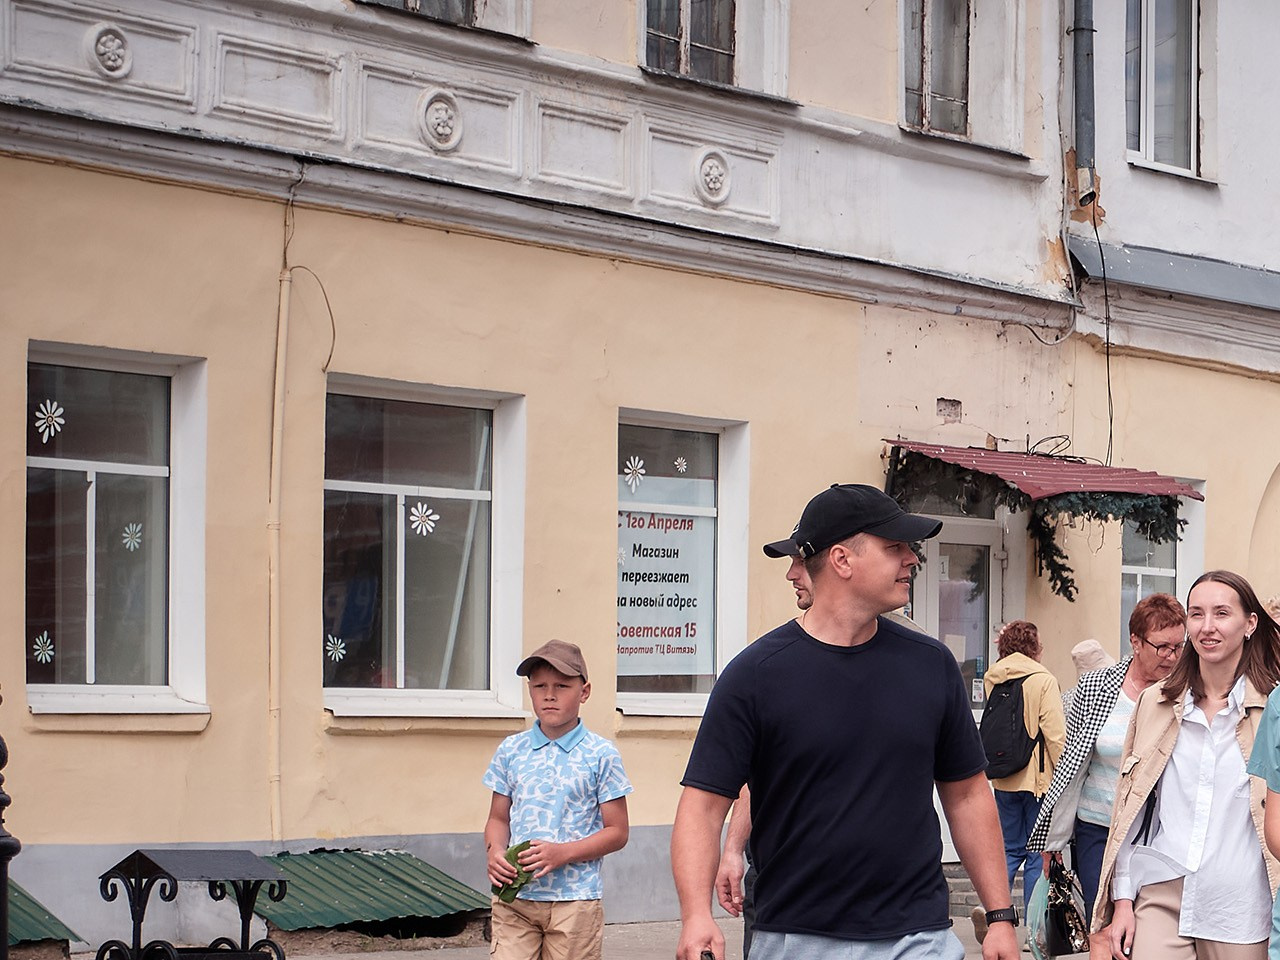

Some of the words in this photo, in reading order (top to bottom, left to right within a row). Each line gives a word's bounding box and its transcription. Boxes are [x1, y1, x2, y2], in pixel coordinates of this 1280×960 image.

[626, 512, 645, 529] 1го
[647, 513, 694, 533] Апреля
[632, 543, 680, 559] Магазин
[621, 571, 690, 586] переезжает
[629, 593, 665, 608] новый
[666, 593, 698, 611] адрес
[684, 622, 697, 638] 15
[655, 644, 665, 655] ТЦ
[666, 643, 697, 656] Витязь)
